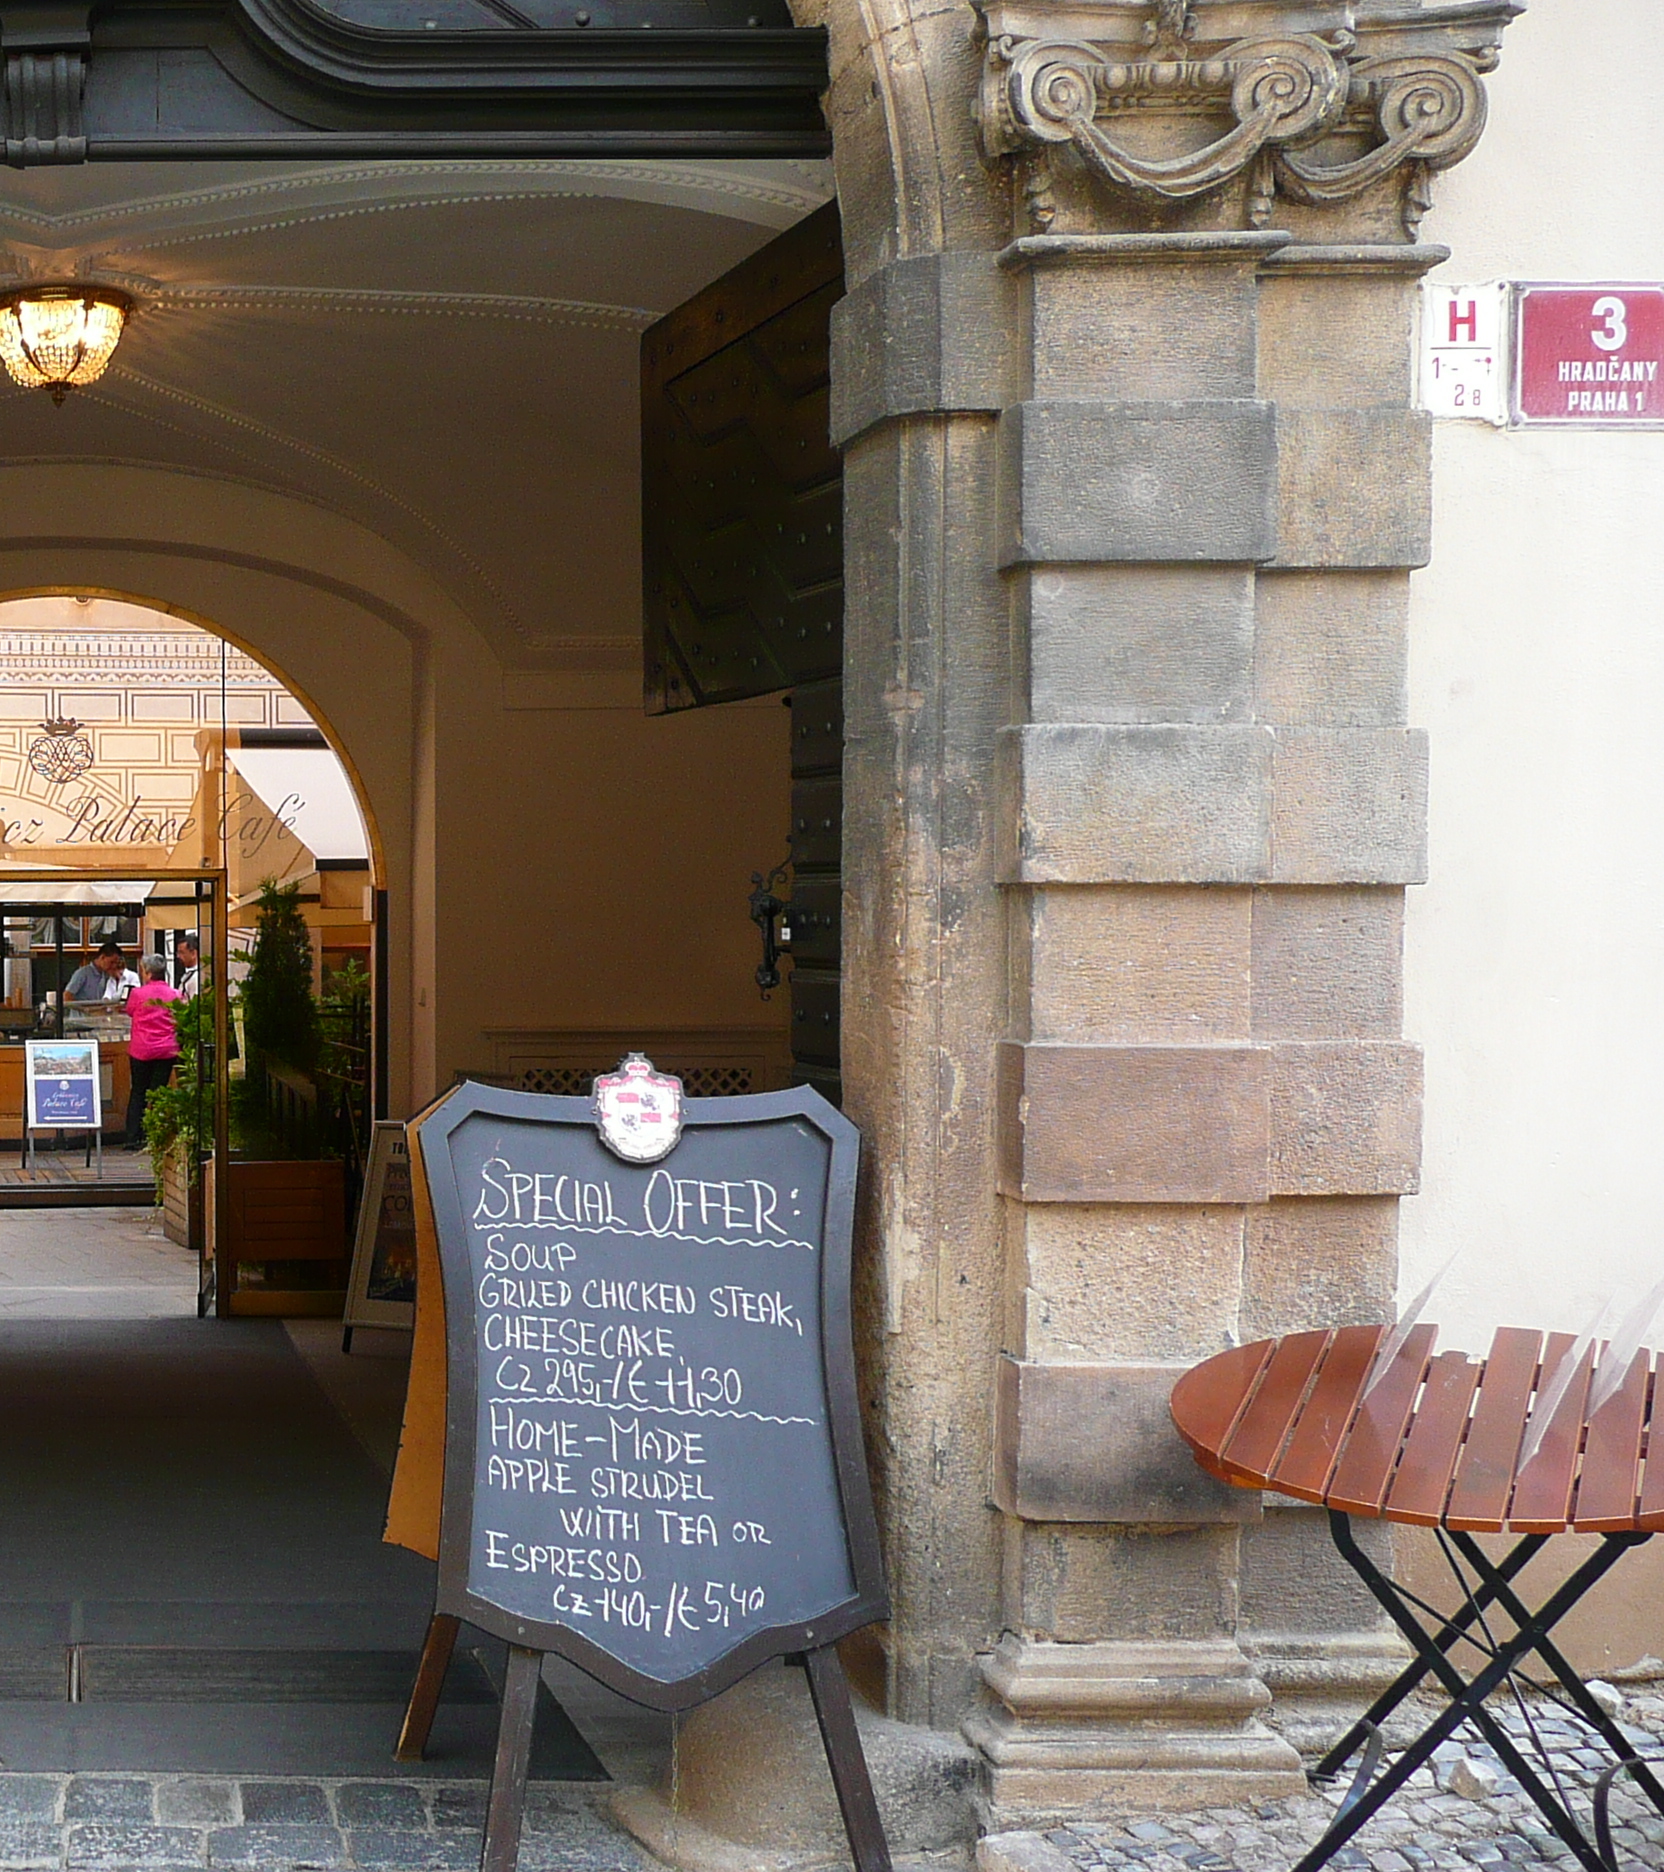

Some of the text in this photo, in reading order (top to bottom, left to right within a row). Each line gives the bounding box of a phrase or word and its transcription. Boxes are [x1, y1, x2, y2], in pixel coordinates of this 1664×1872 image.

[1448, 300, 1476, 341] H
[1591, 296, 1628, 351] 3
[1557, 356, 1659, 382] HRADČANY
[1567, 391, 1645, 412] PRAHA 1
[56, 795, 197, 844] Palace
[216, 792, 306, 859] Café
[472, 1156, 802, 1236] SPECIAL OFFER:
[484, 1234, 577, 1273] SOUP
[582, 1279, 696, 1315] CHICKEN
[708, 1284, 804, 1337] STEAK,
[483, 1313, 686, 1367] CHEESECAKE,
[488, 1404, 708, 1466] HOME-MADE
[487, 1454, 715, 1502] APPLE STRUDEL
[559, 1505, 773, 1548] WITH TEA OR
[484, 1530, 643, 1584] ESPRESSO
